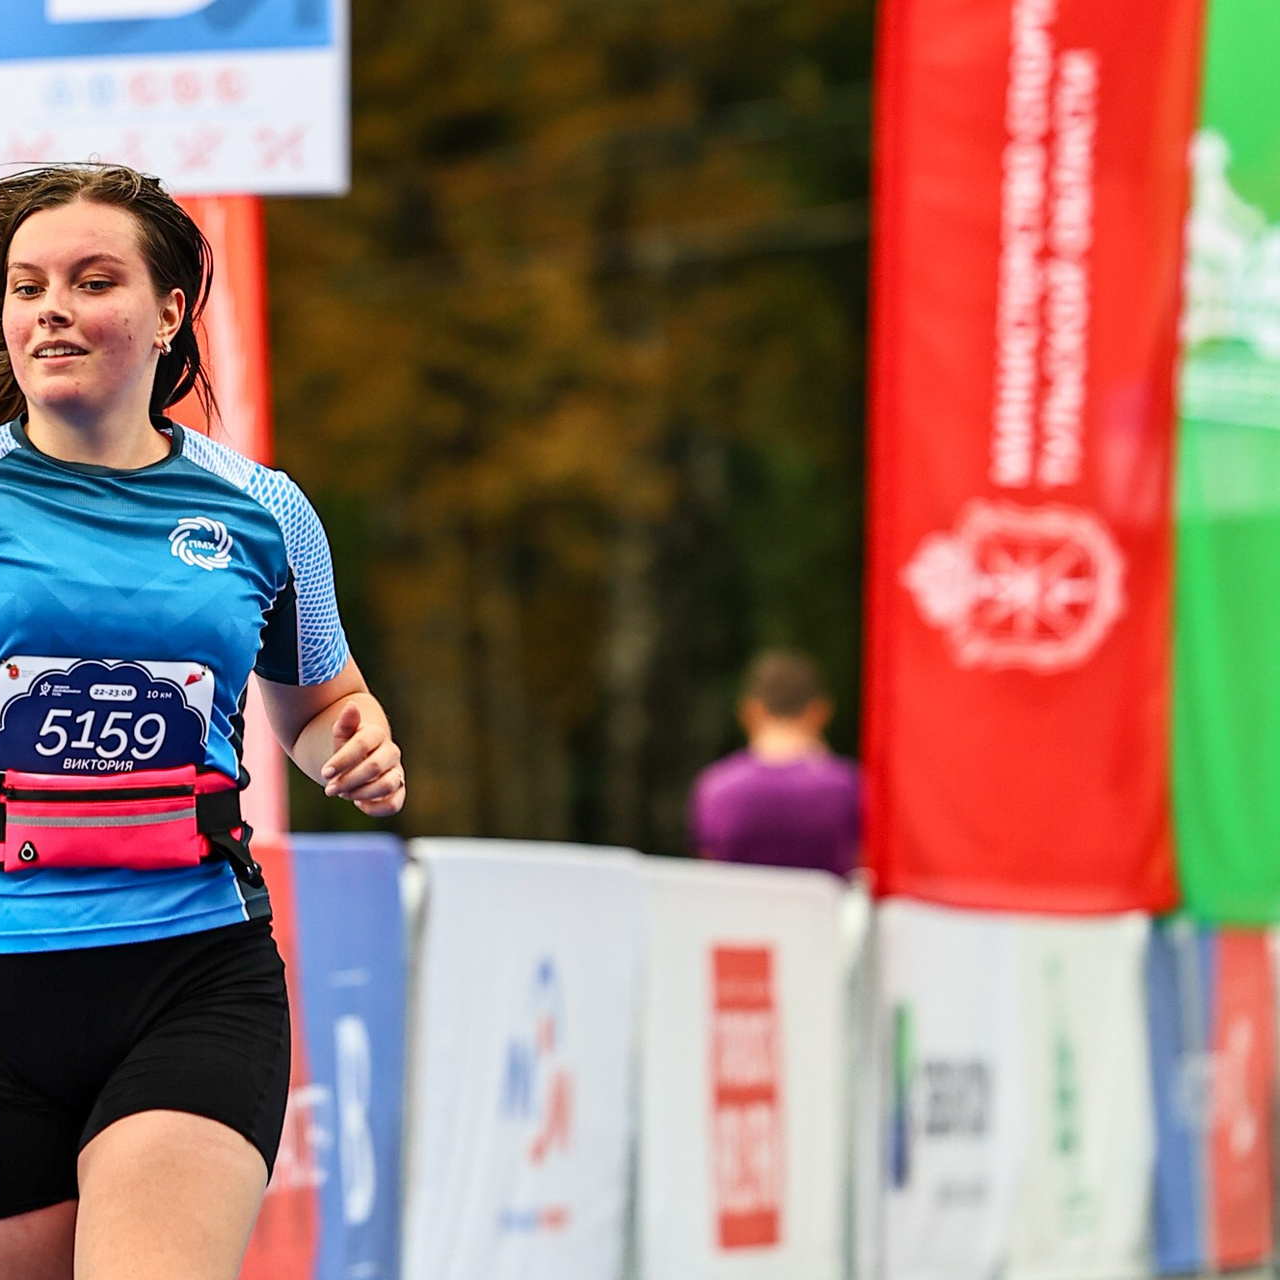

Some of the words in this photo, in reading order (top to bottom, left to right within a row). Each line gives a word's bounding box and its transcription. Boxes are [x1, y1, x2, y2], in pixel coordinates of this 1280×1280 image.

[188, 540, 216, 551] ПМХ
[93, 687, 133, 698] 22-23.08
[146, 689, 157, 699] 10
[35, 708, 166, 760] 5159
[62, 758, 134, 771] ВИКТОРИЯ
